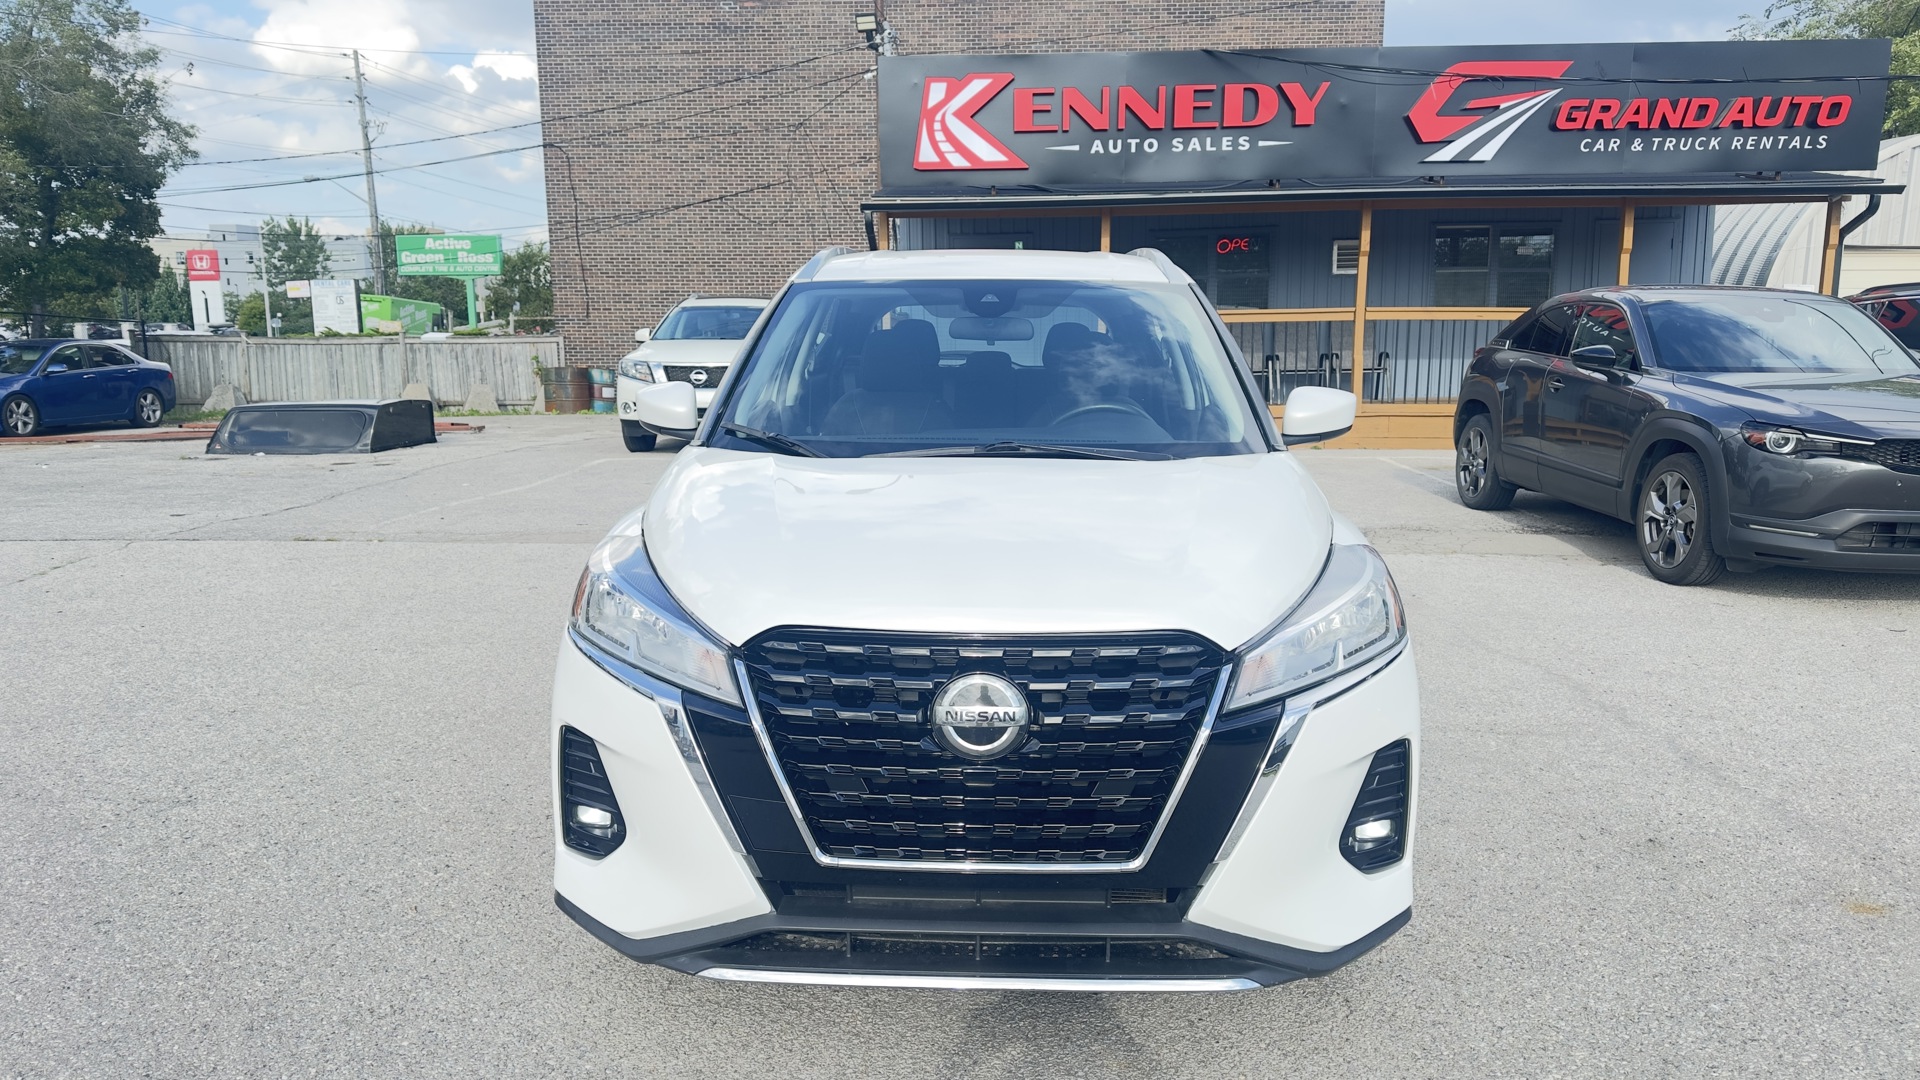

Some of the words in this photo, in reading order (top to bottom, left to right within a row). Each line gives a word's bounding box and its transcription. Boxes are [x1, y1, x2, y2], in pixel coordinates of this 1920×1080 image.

[913, 72, 1331, 170] KENNEDY
[1556, 97, 1720, 130] GRAND
[1718, 95, 1852, 128] AUTO
[1090, 138, 1159, 154] AUTO
[1171, 136, 1250, 152] SALES
[1580, 138, 1620, 152] CAR
[1630, 137, 1644, 152] &
[1652, 137, 1721, 151] TRUCK
[1731, 135, 1828, 150] RENTALS
[424, 238, 472, 250] Active
[401, 251, 445, 263] Green
[457, 251, 494, 263] Ross
[945, 710, 1016, 723] NISSAN
